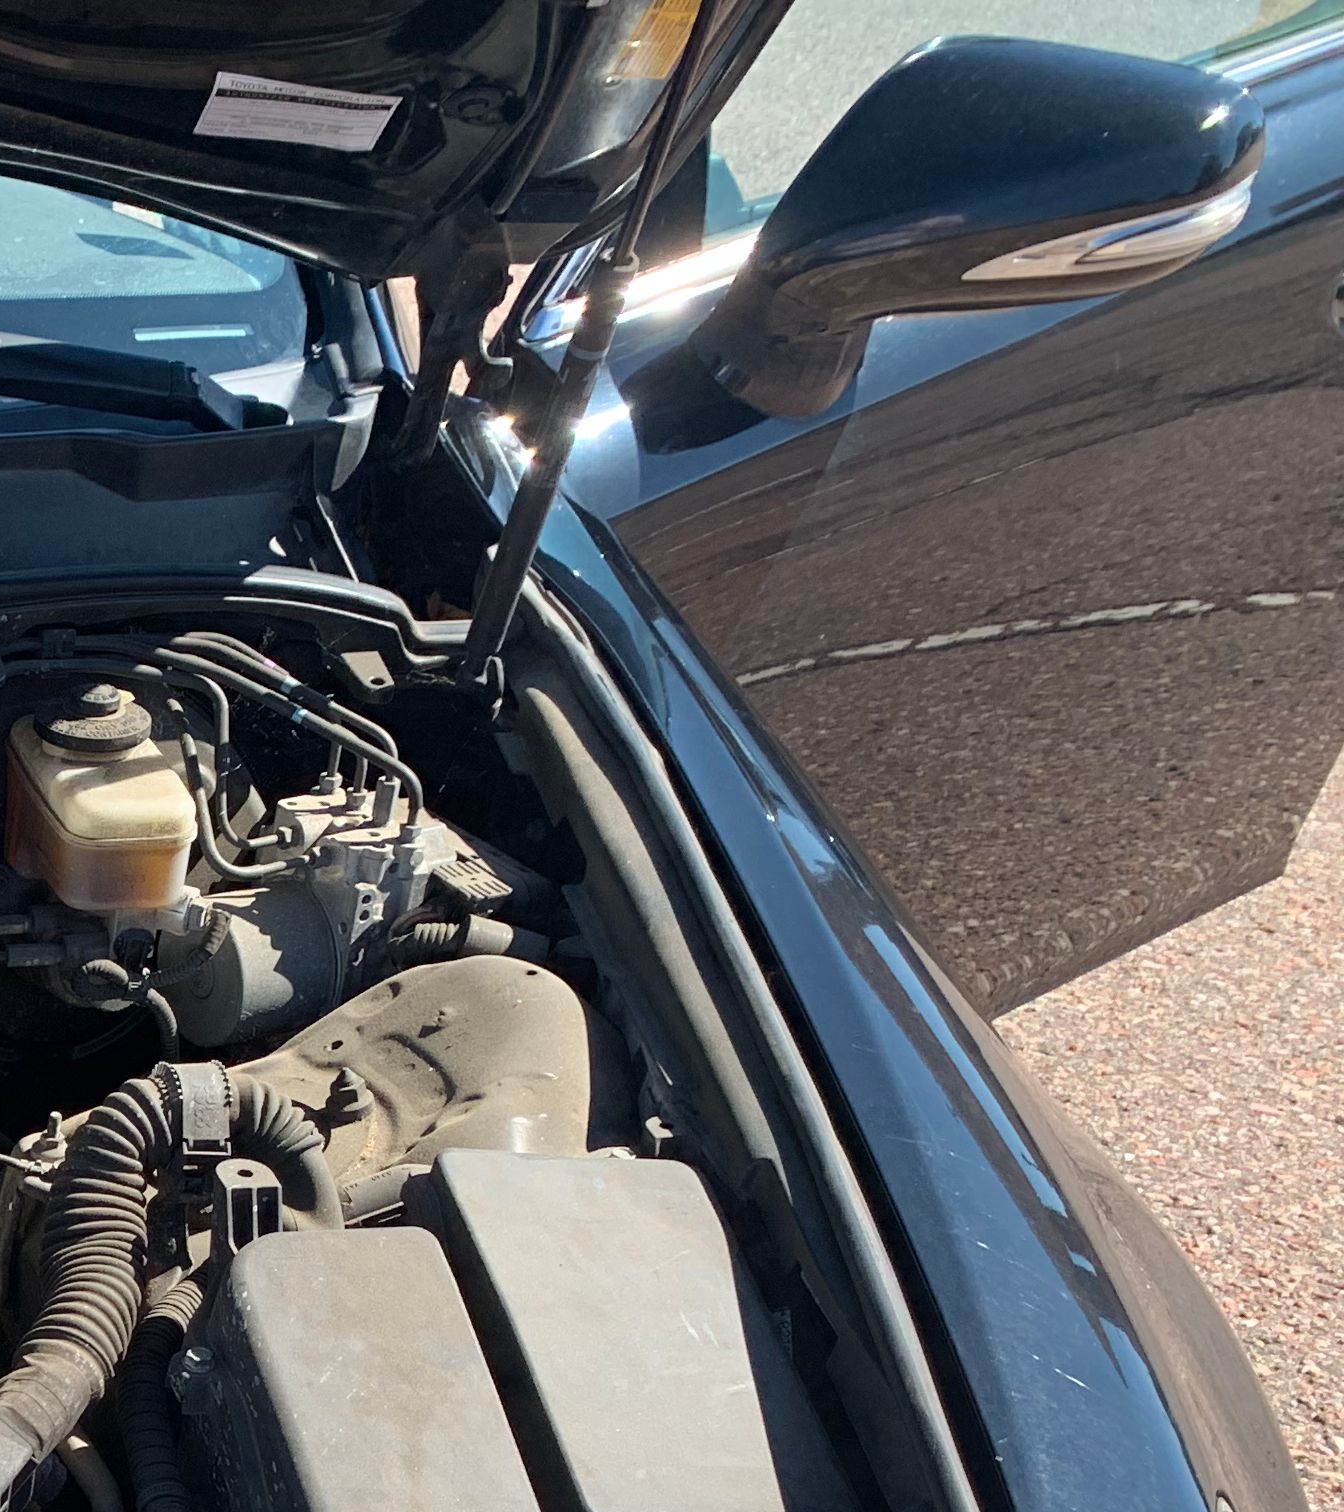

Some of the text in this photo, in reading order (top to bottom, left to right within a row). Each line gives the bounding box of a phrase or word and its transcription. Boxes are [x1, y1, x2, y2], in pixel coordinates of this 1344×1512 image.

[229, 79, 386, 104] TOYOTA MOTOR CORPORATION
